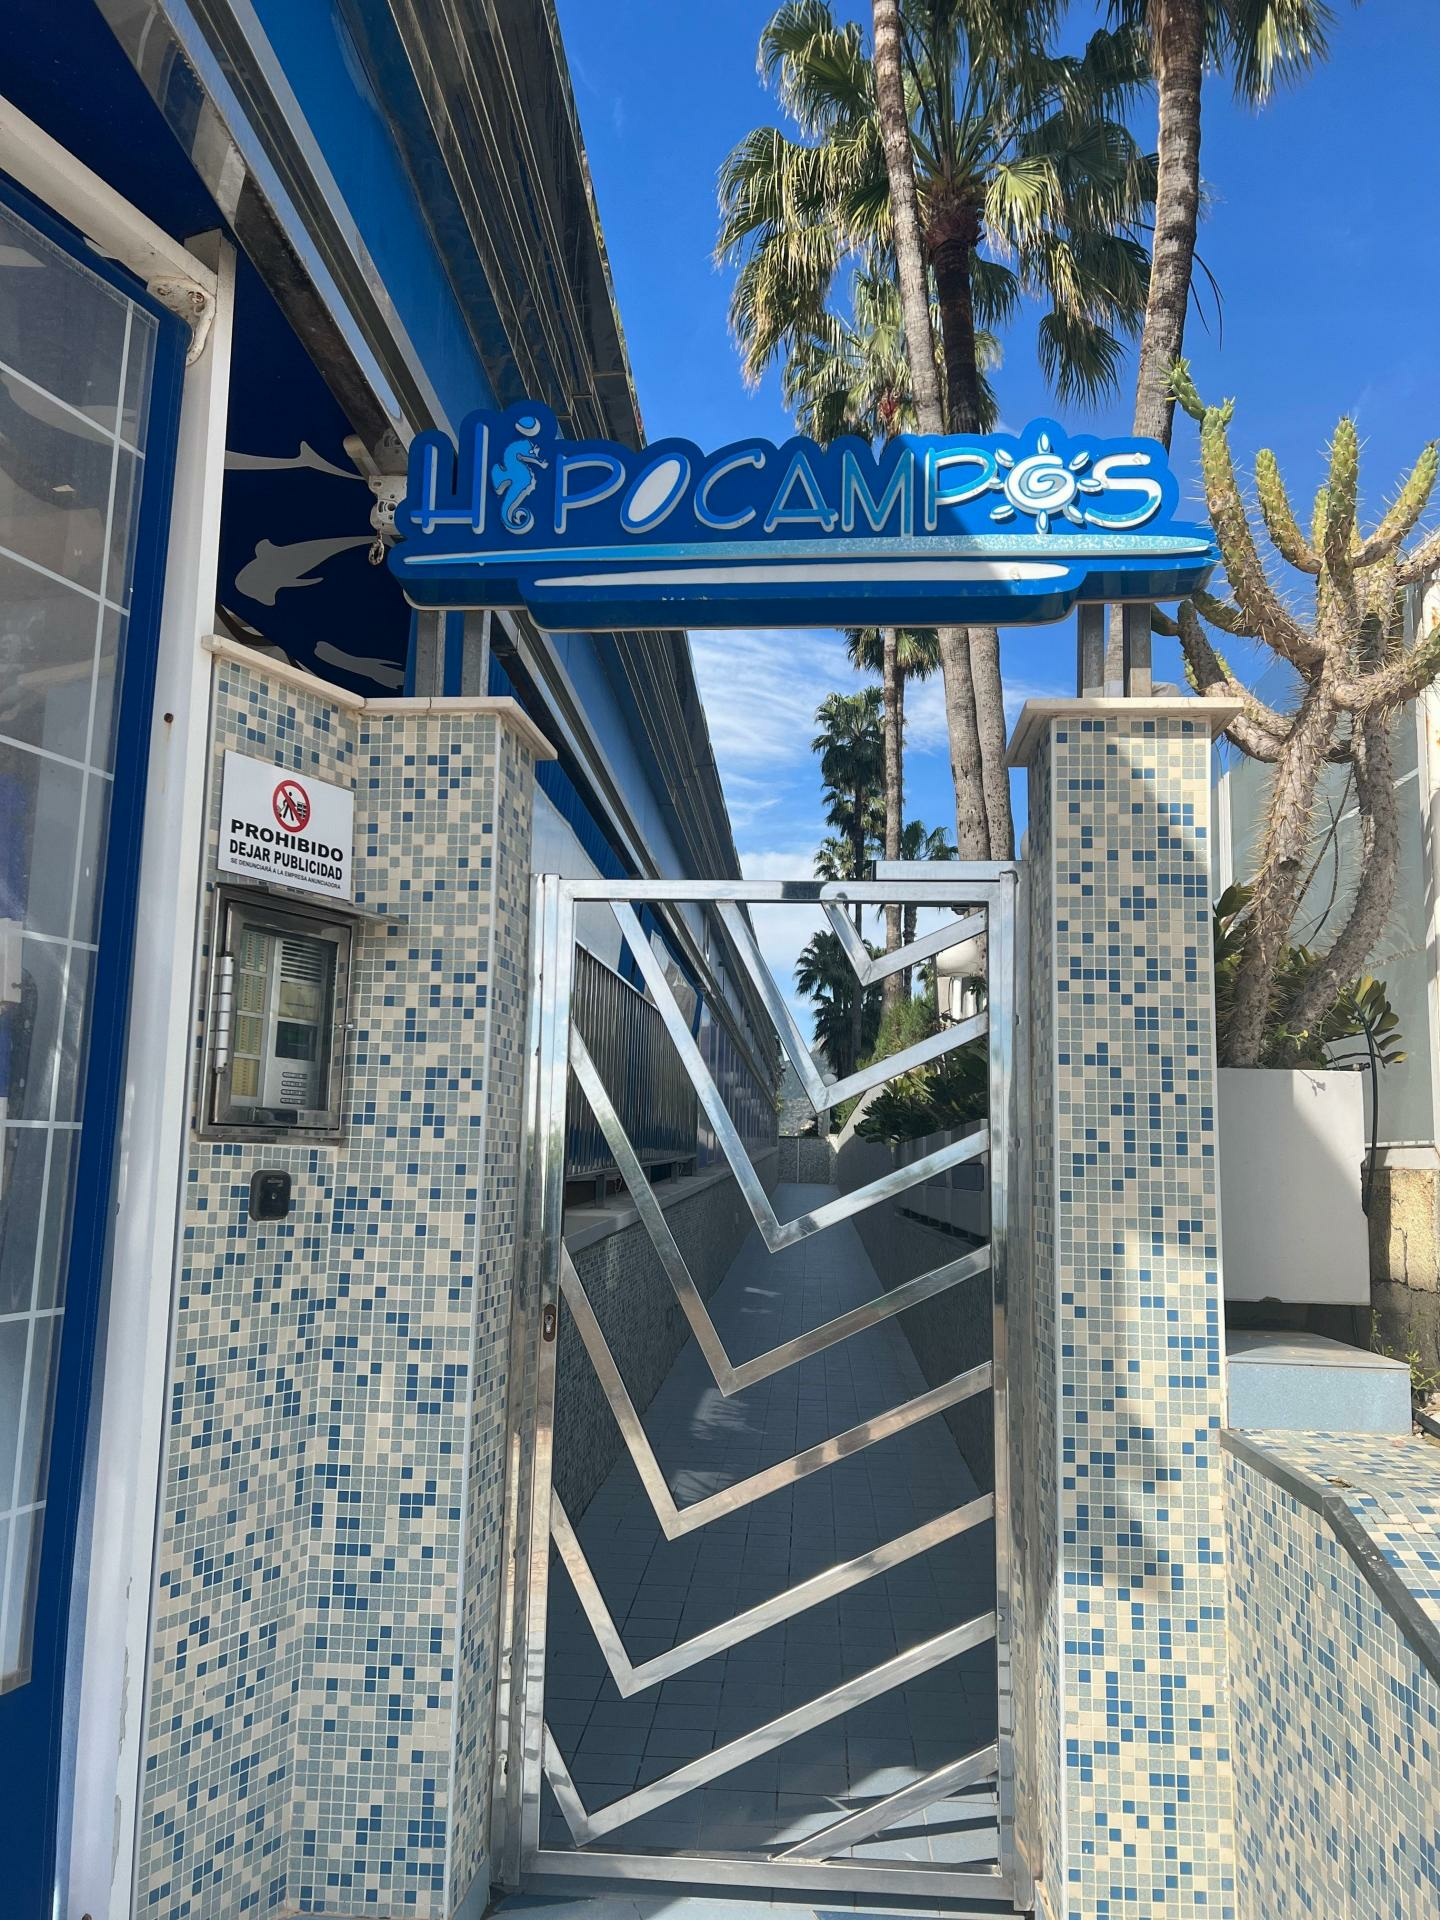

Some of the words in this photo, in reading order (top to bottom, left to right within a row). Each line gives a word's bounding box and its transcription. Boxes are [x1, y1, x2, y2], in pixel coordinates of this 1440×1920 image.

[229, 839, 270, 862] DEJAR
[273, 850, 343, 880] PUBLICIDAD
[231, 818, 344, 862] PROHIBIDO
[230, 857, 238, 865] SE
[284, 870, 307, 882] EMPRESA
[307, 876, 341, 889] ANUNCIADORA
